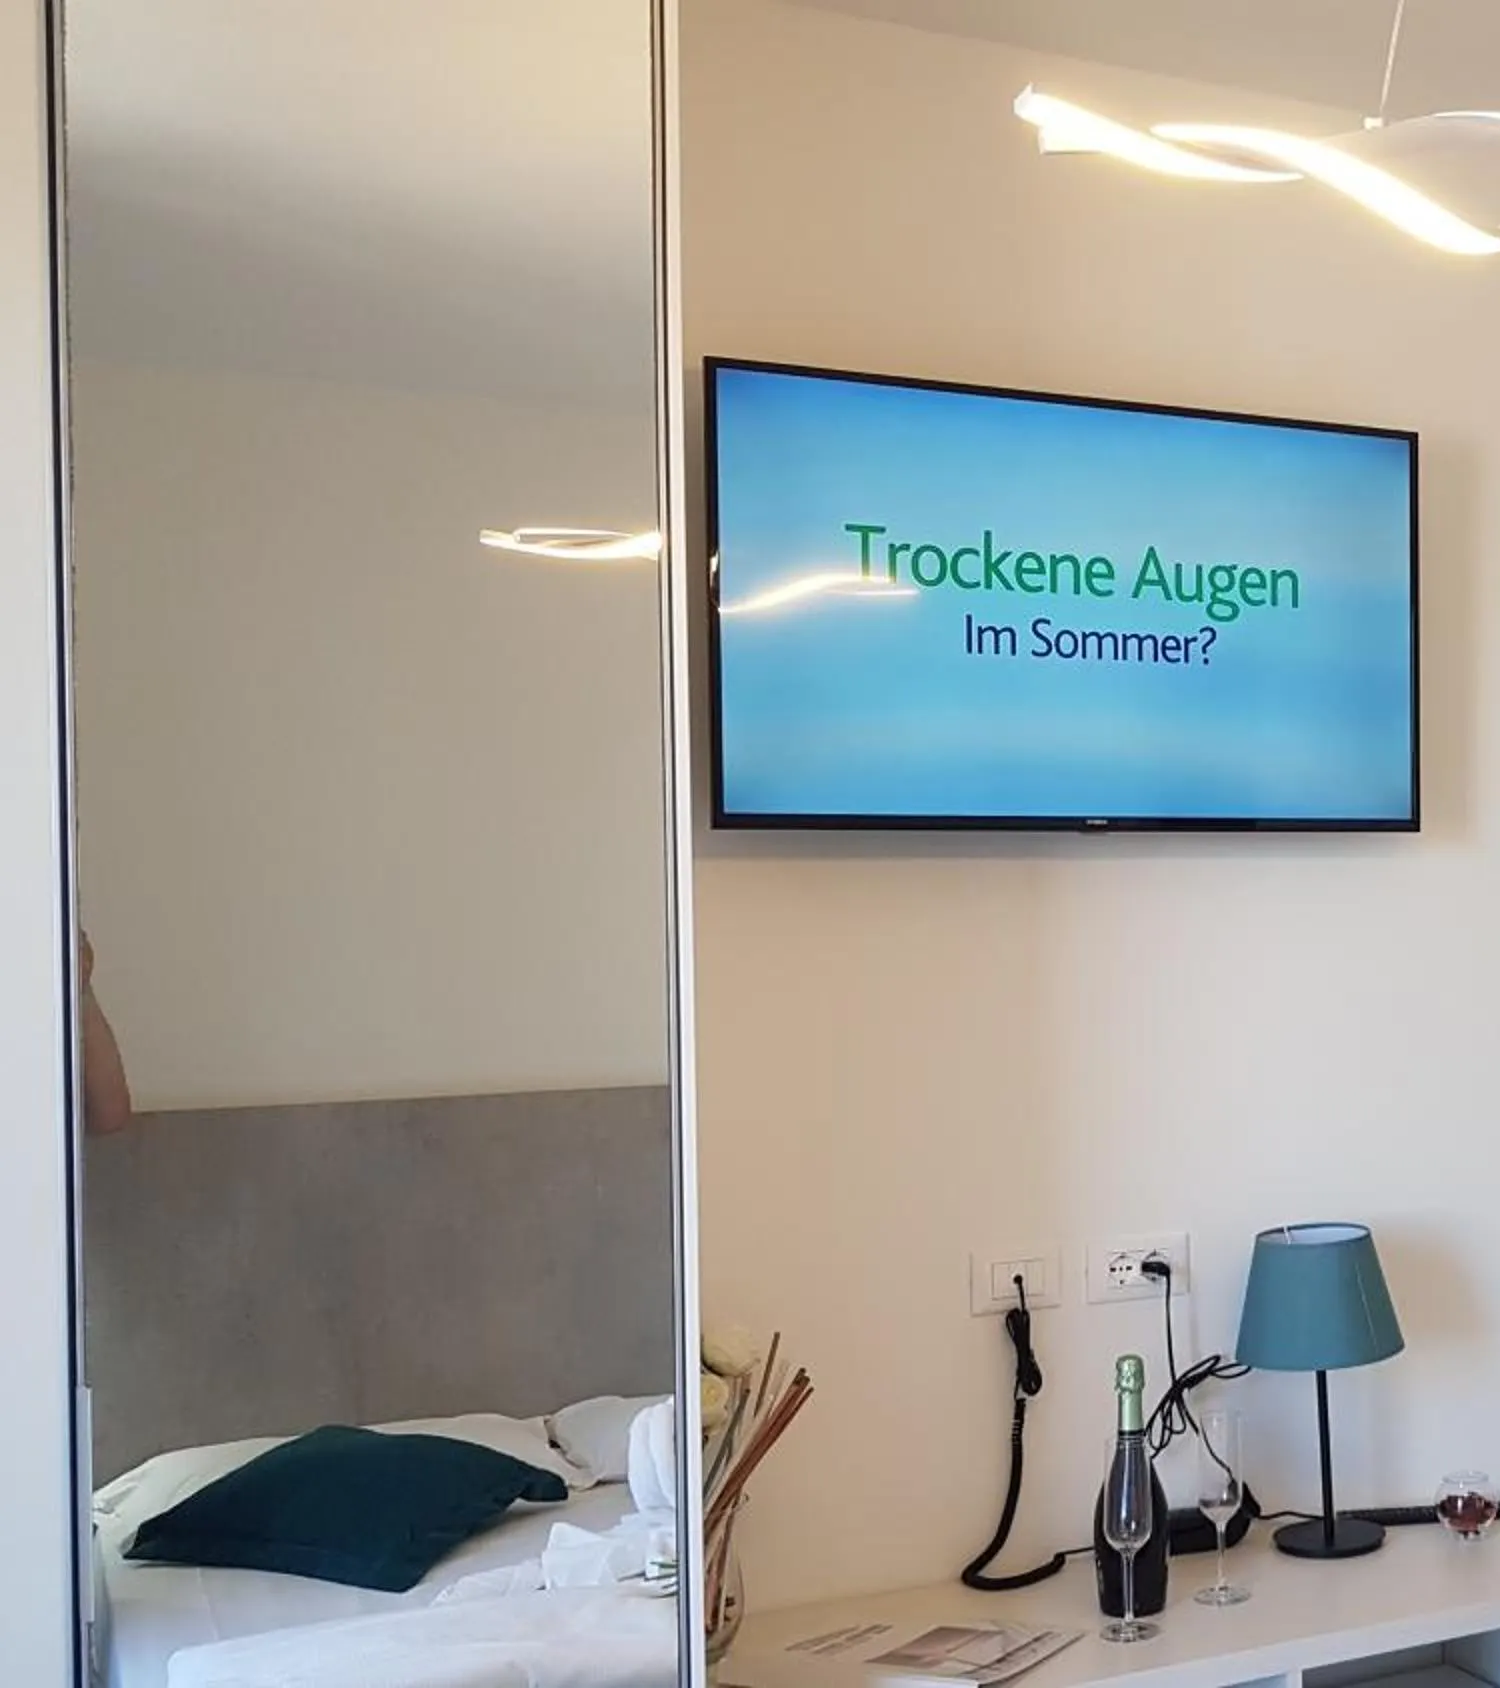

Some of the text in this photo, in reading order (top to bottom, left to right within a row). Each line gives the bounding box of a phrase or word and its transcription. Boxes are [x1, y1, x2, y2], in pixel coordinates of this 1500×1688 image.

[845, 523, 1300, 622] Trockene Augen
[964, 614, 1217, 665] Im Sommer?
